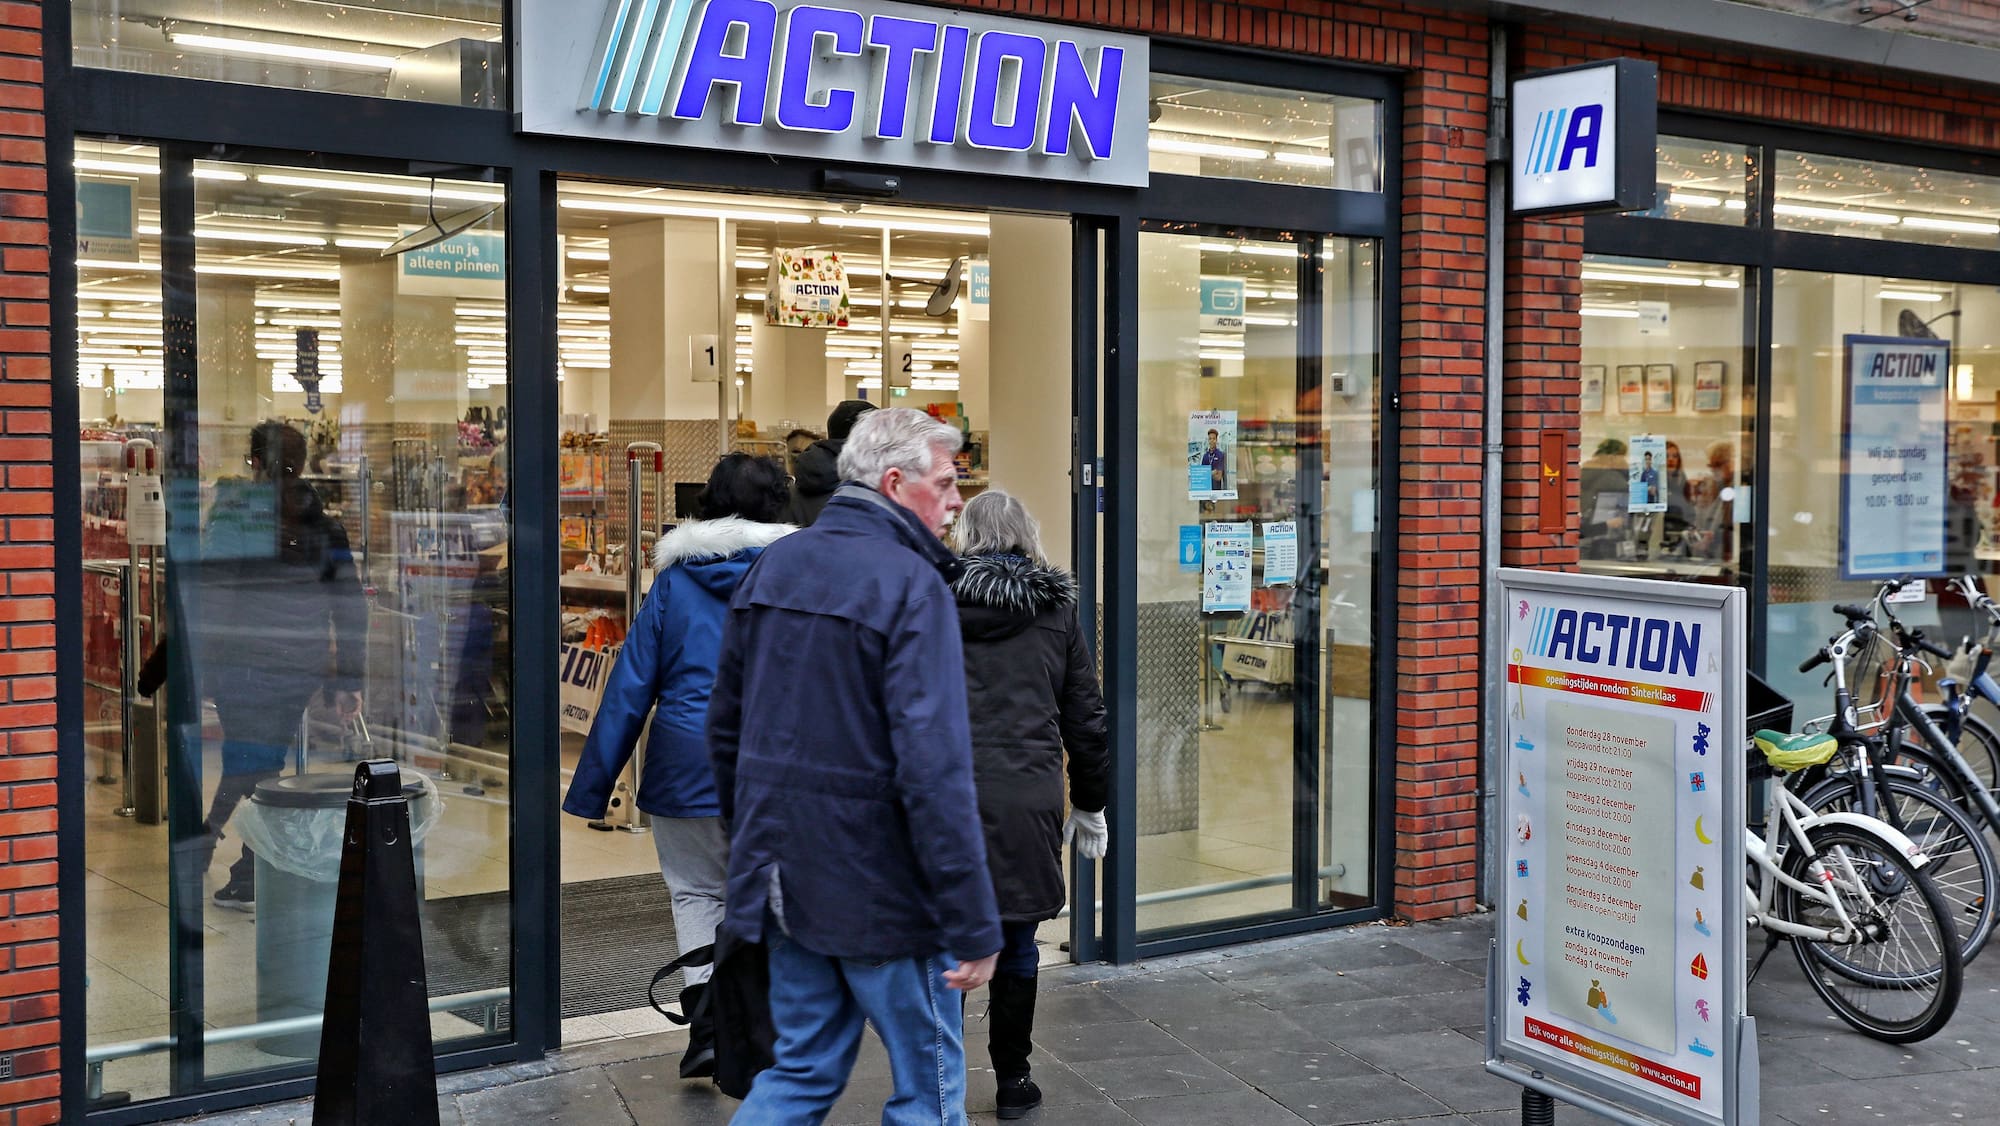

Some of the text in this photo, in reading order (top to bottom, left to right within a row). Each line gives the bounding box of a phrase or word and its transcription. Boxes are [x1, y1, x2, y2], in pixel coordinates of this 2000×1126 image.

[672, 0, 1125, 160] ACTION
[1558, 104, 1603, 171] A
[439, 241, 464, 255] kun
[466, 242, 480, 257] je
[409, 257, 500, 273] alleen pinnen
[975, 272, 990, 285] hie
[796, 284, 840, 296] ACTION
[705, 345, 714, 366] 1
[902, 353, 912, 372] 2
[1870, 353, 1937, 378] ACTION
[1898, 445, 1927, 461] zondag
[1269, 525, 1294, 533] ACTION
[1547, 609, 1701, 677] ACTION
[561, 645, 603, 692] ION
[1236, 654, 1268, 669] ACTION
[1545, 674, 1677, 702] openingstijden rondom Sinterklaas
[563, 704, 591, 722] ACTION
[1566, 725, 1647, 748] donderdag 28 november
[1566, 738, 1632, 758] koopavond tot 21:00
[1567, 759, 1633, 778] vrijdag 29 november
[1566, 769, 1632, 791] koopavond tot 21:00
[1566, 790, 1636, 811] maandag 2 december
[1566, 800, 1632, 824] koopavond tot 20:00
[1565, 821, 1631, 843] dinsdag 3 december
[1566, 833, 1600, 849] koopavond
[1601, 843, 1611, 852] tot
[1566, 854, 1639, 878] woensdag 4 december
[1566, 864, 1600, 880] koopavond
[1601, 874, 1611, 884] tot
[1566, 883, 1642, 911] donderdag 5 december
[1566, 897, 1636, 924] reguliere openingstijd
[1565, 925, 1645, 955] extra koopzondagen
[1565, 941, 1633, 967] zondag 24 november
[1565, 953, 1629, 979] zondag 1 december
[1528, 1023, 1697, 1092] kijk voor alle openingstijden op www.action.nl
